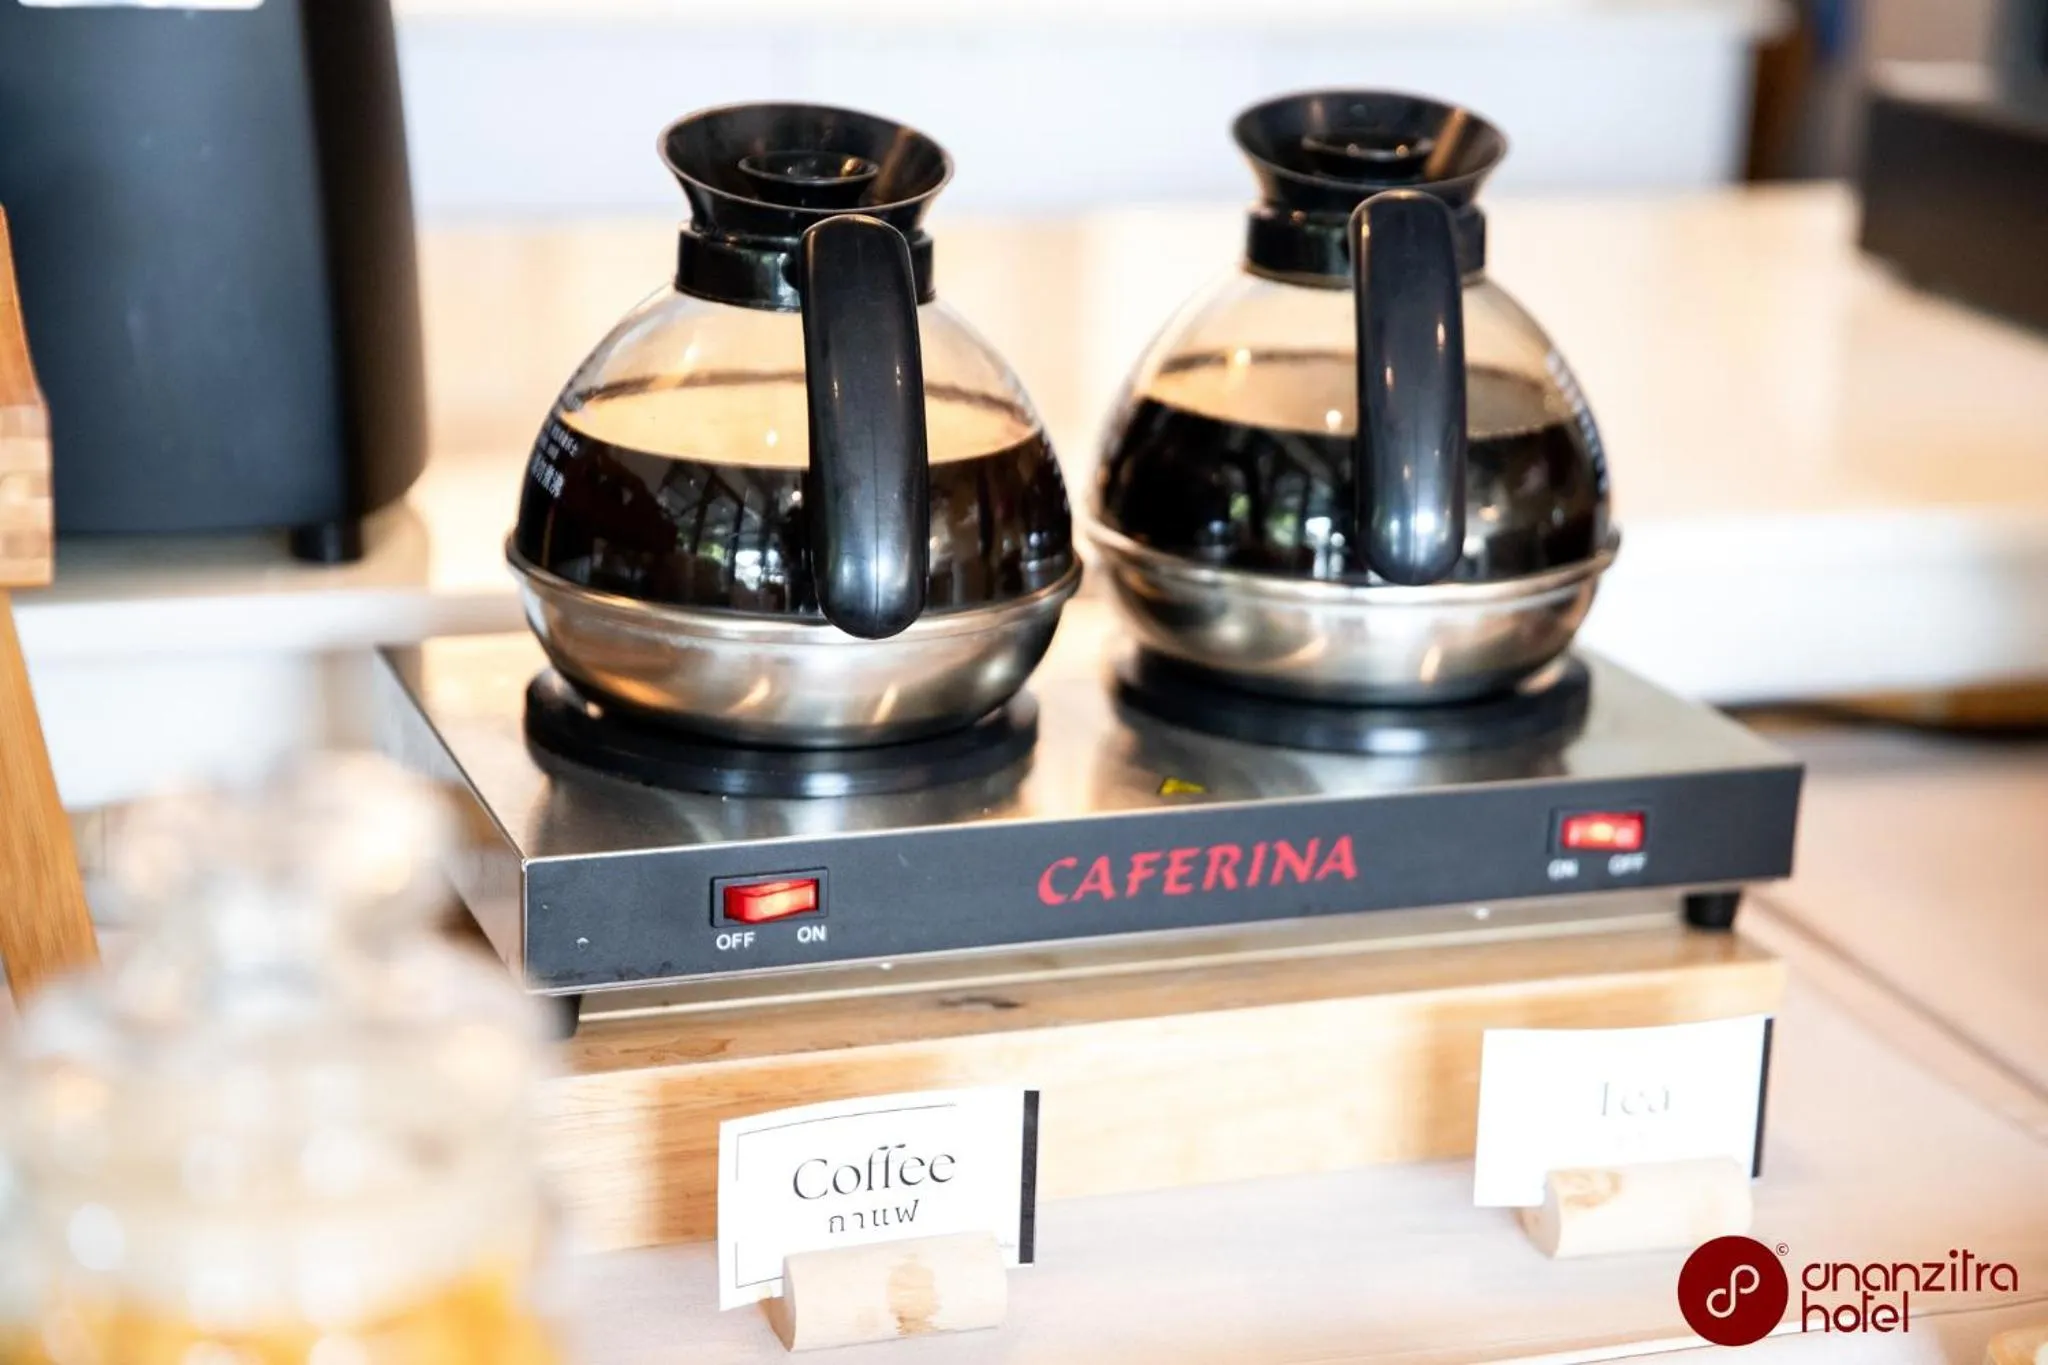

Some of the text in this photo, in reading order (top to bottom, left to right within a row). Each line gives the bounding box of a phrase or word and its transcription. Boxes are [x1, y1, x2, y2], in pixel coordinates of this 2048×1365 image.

[1038, 834, 1358, 905] CAFERINA
[1547, 853, 1647, 880] ON OFF
[716, 924, 828, 951] OFF ON
[792, 1143, 957, 1201] Coffee
[828, 1199, 920, 1233] กาแฟ
